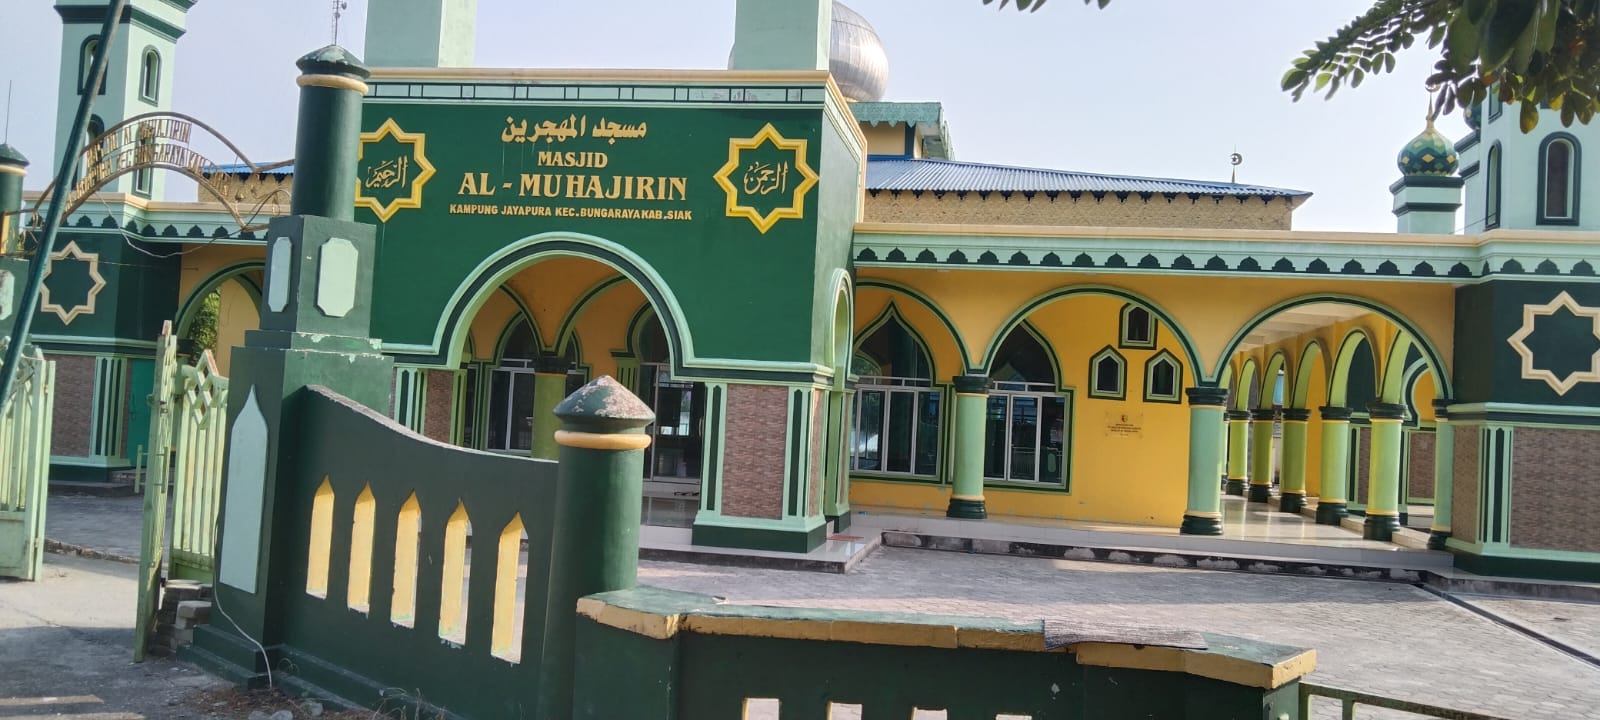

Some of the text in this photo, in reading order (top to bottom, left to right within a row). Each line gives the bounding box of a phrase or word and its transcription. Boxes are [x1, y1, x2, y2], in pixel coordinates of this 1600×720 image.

[593, 118, 646, 144] مسجد
[538, 152, 607, 167] MASJID
[458, 173, 495, 195] AL
[519, 174, 686, 200] MUHAJIRIN
[450, 205, 498, 214] KAMPUNG
[502, 206, 551, 216] JAYAPURA
